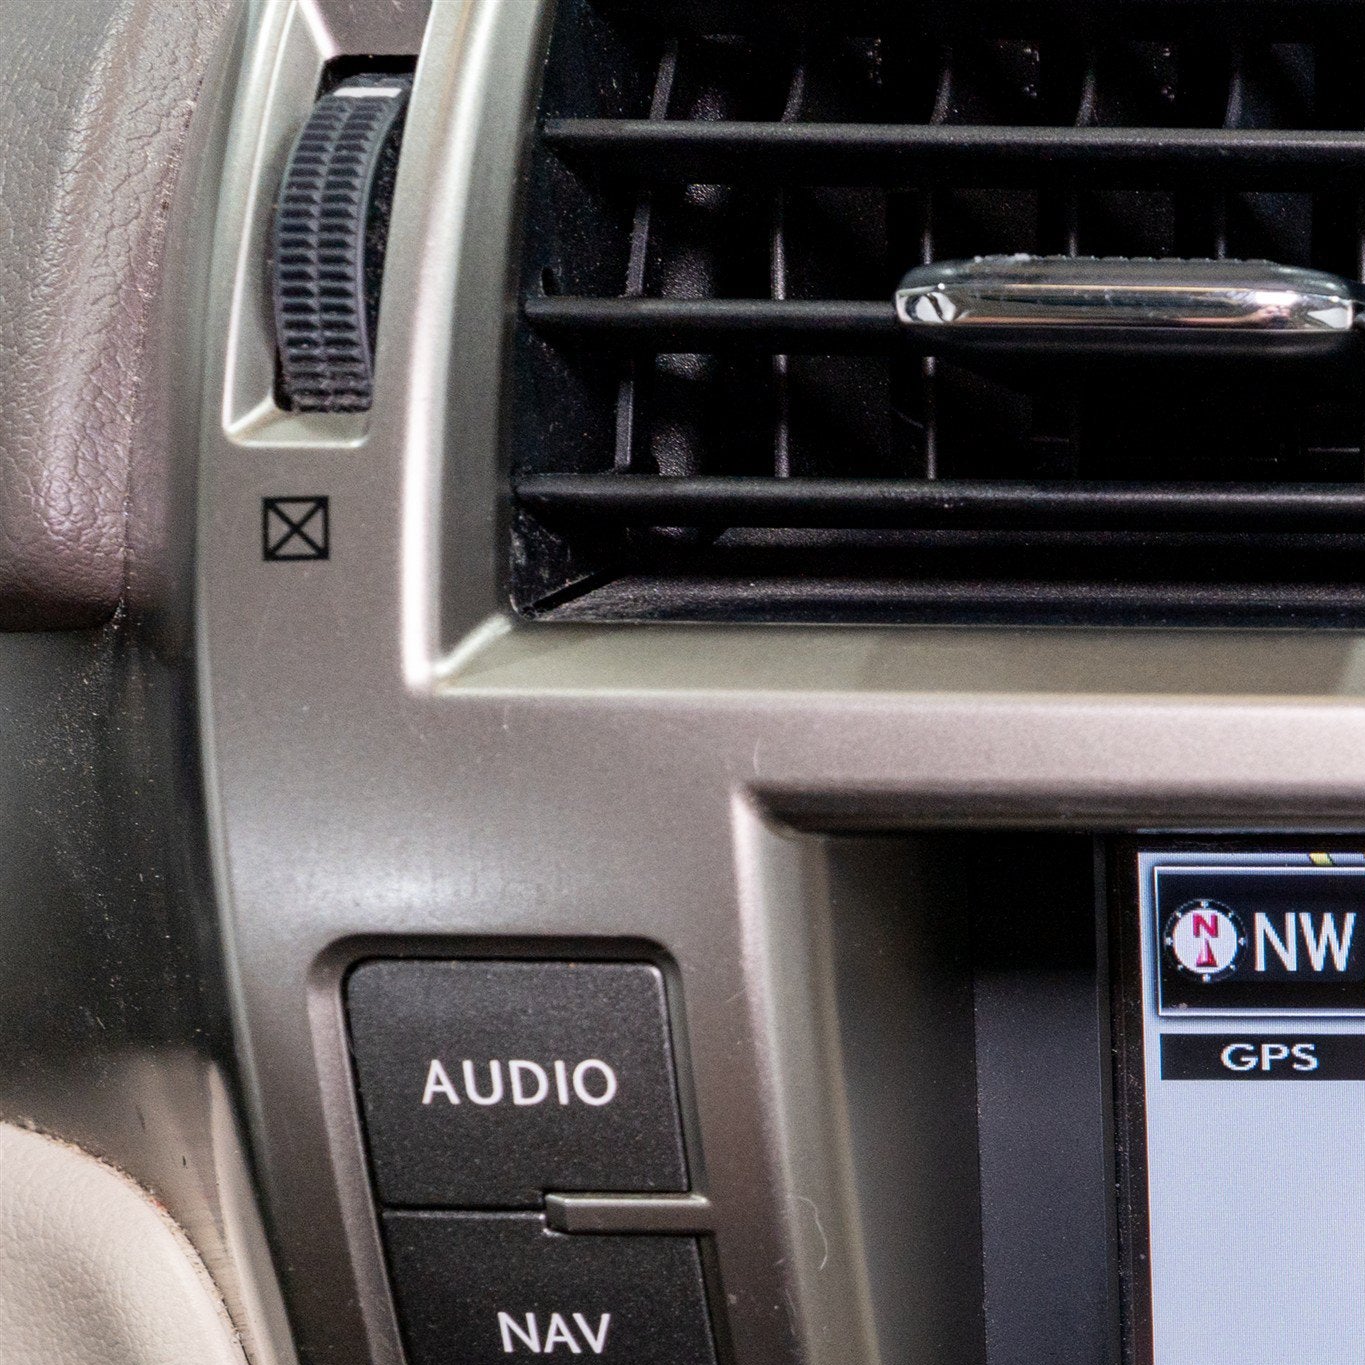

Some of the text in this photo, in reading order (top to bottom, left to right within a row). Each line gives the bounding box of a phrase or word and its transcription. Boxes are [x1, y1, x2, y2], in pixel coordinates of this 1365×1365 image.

[1193, 914, 1218, 938] N
[1255, 913, 1355, 971] NW
[1221, 1044, 1318, 1070] GPS
[423, 1059, 617, 1106] AUDIO
[498, 1312, 610, 1353] NAV
